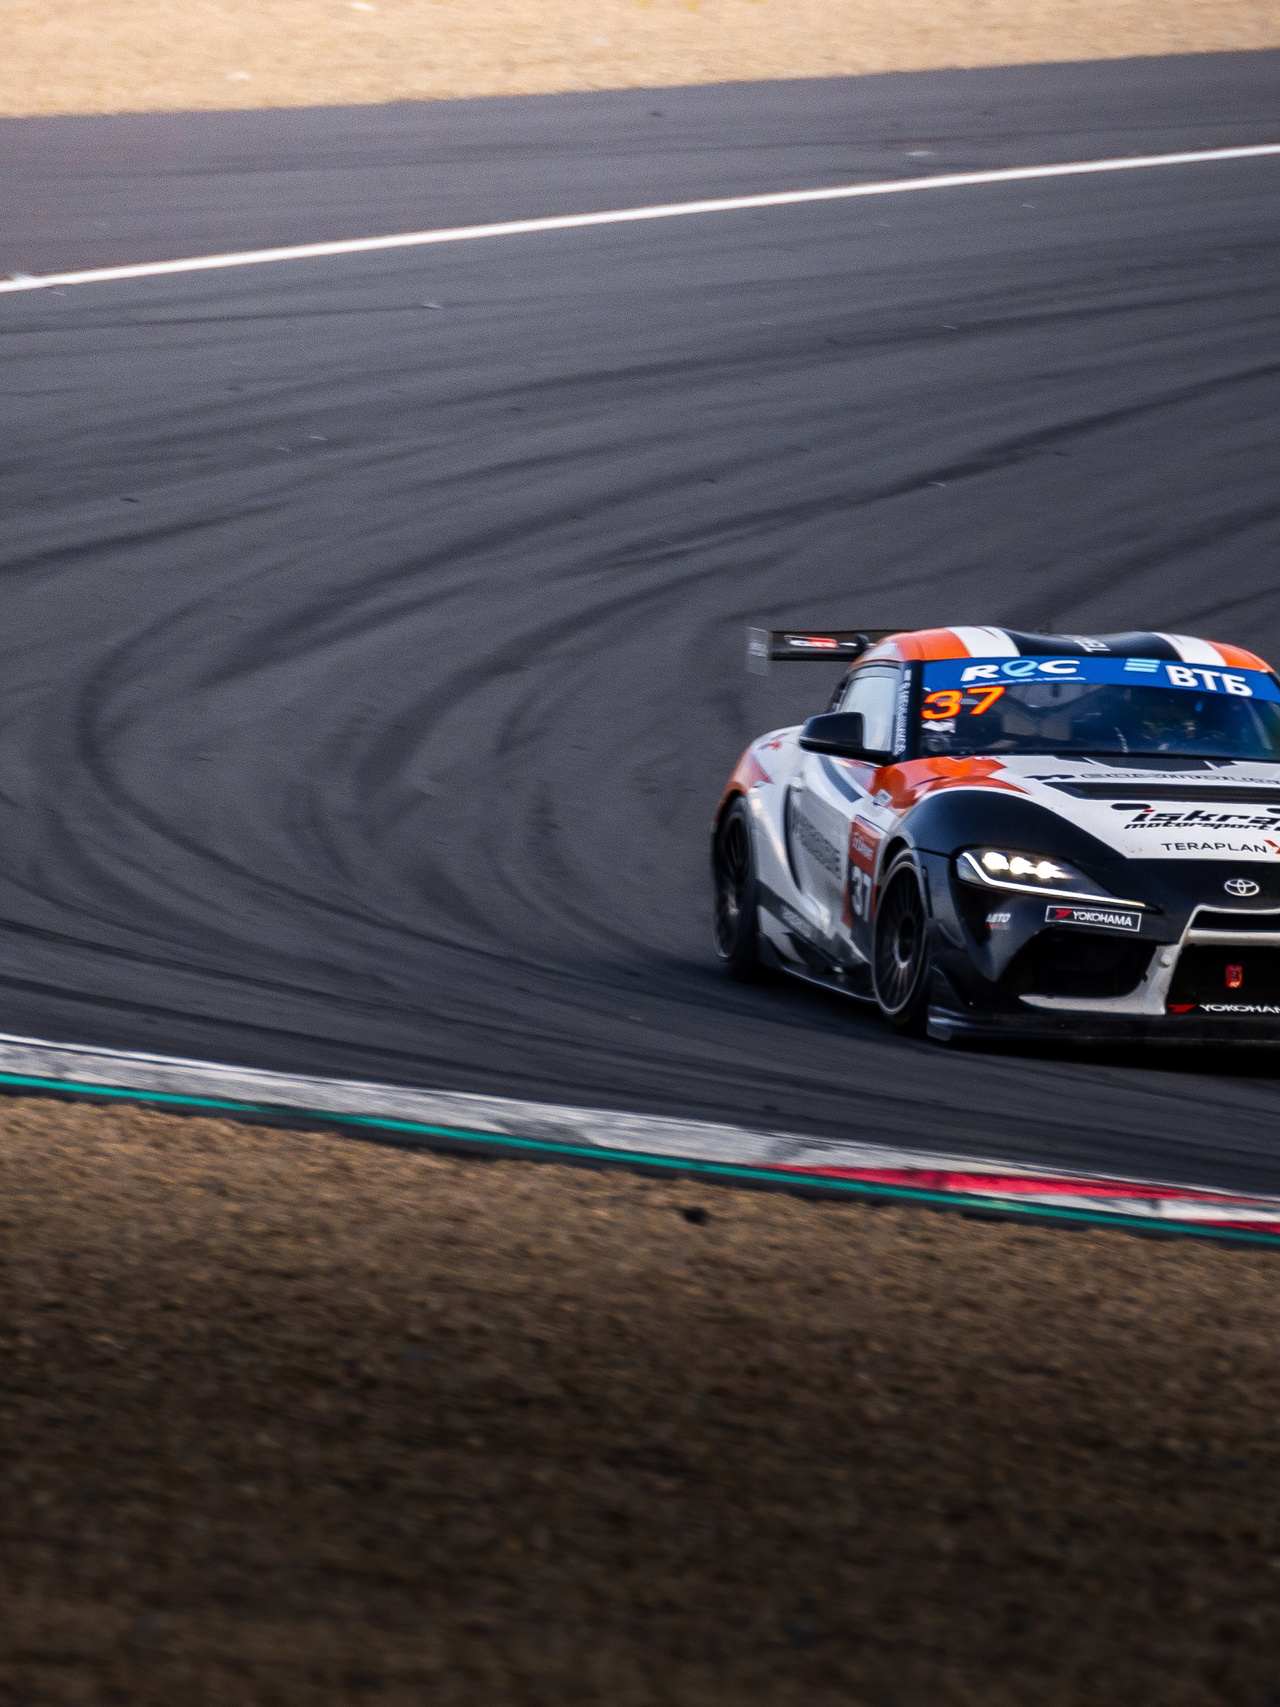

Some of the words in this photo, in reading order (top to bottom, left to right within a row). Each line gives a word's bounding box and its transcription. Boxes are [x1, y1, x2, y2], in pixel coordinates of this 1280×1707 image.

[1165, 665, 1253, 697] ВТБ
[921, 686, 1006, 720] 37
[1124, 820, 1271, 830] motorsport
[1161, 842, 1267, 853] TERAPLAN
[852, 865, 873, 922] 37
[1072, 910, 1132, 926] YOKOHAMA
